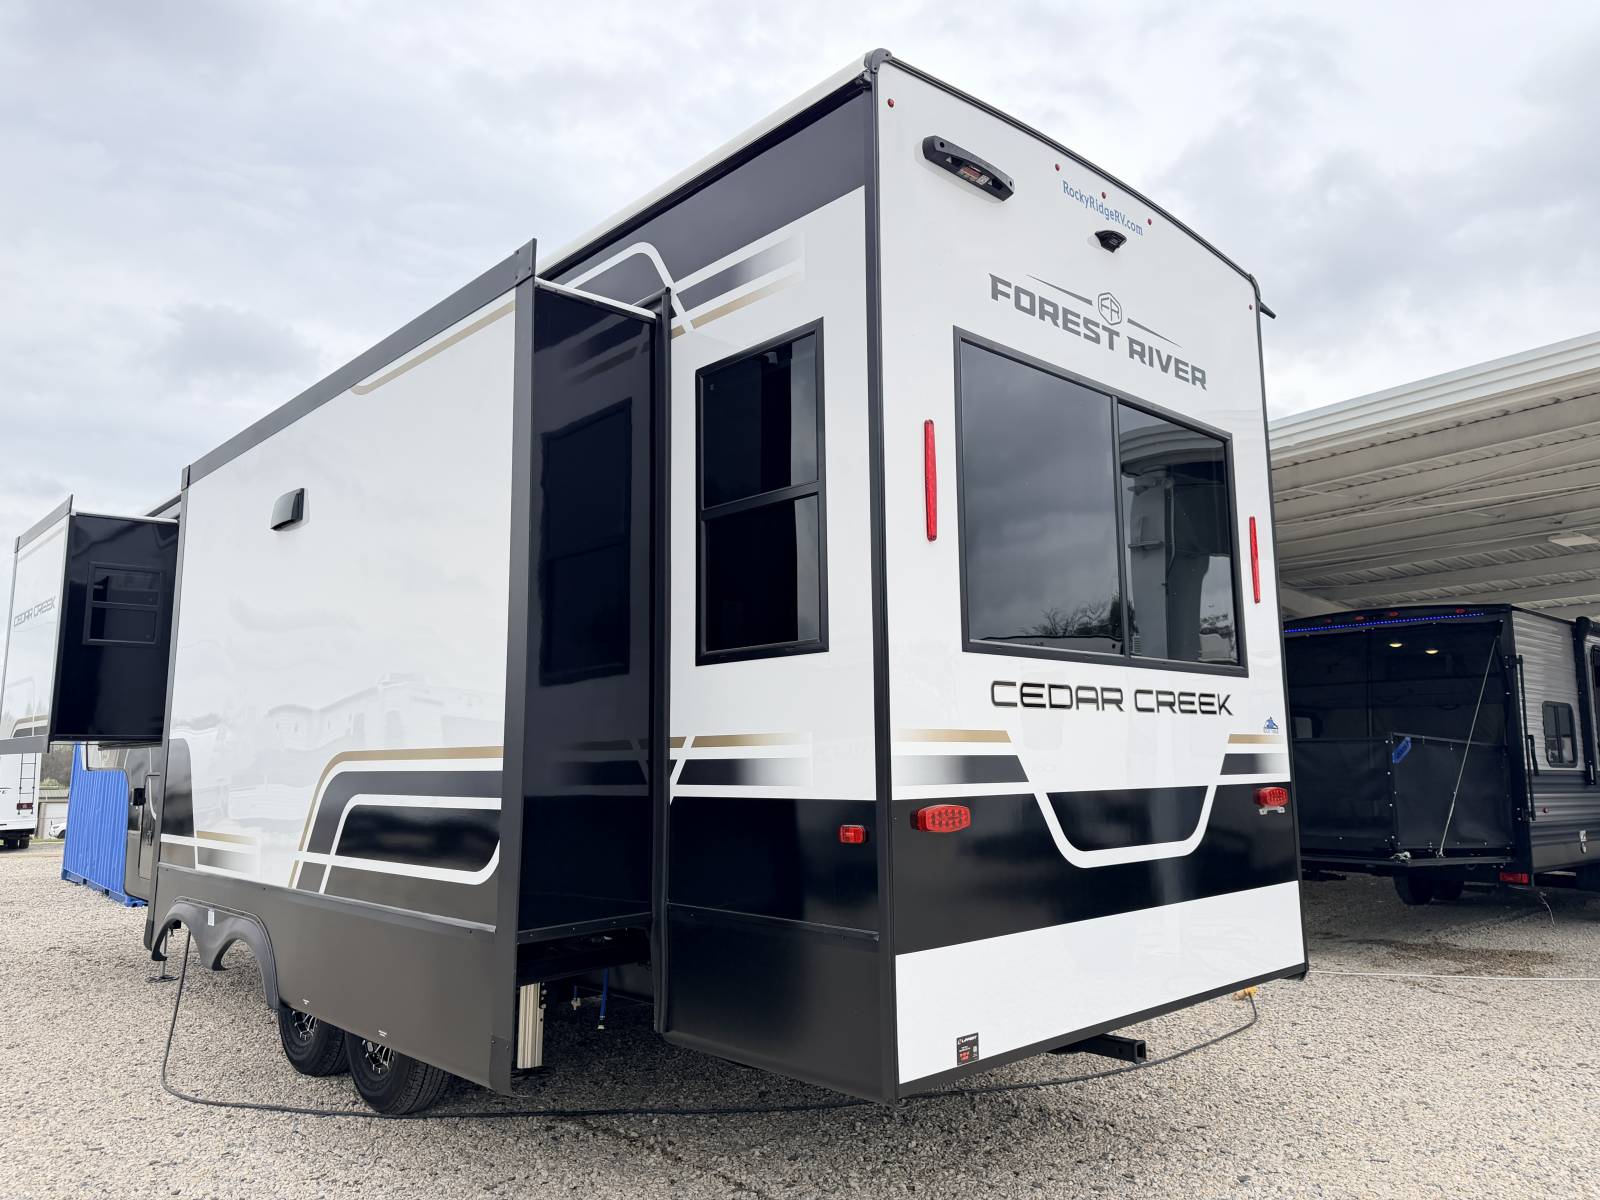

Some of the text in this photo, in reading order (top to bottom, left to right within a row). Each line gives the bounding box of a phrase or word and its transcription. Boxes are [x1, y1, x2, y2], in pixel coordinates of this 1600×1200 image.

[1063, 180, 1143, 236] RockyRidgeRV.com
[989, 273, 1207, 391] FOREST RIVER
[990, 680, 1234, 717] CEDAR CREEK
